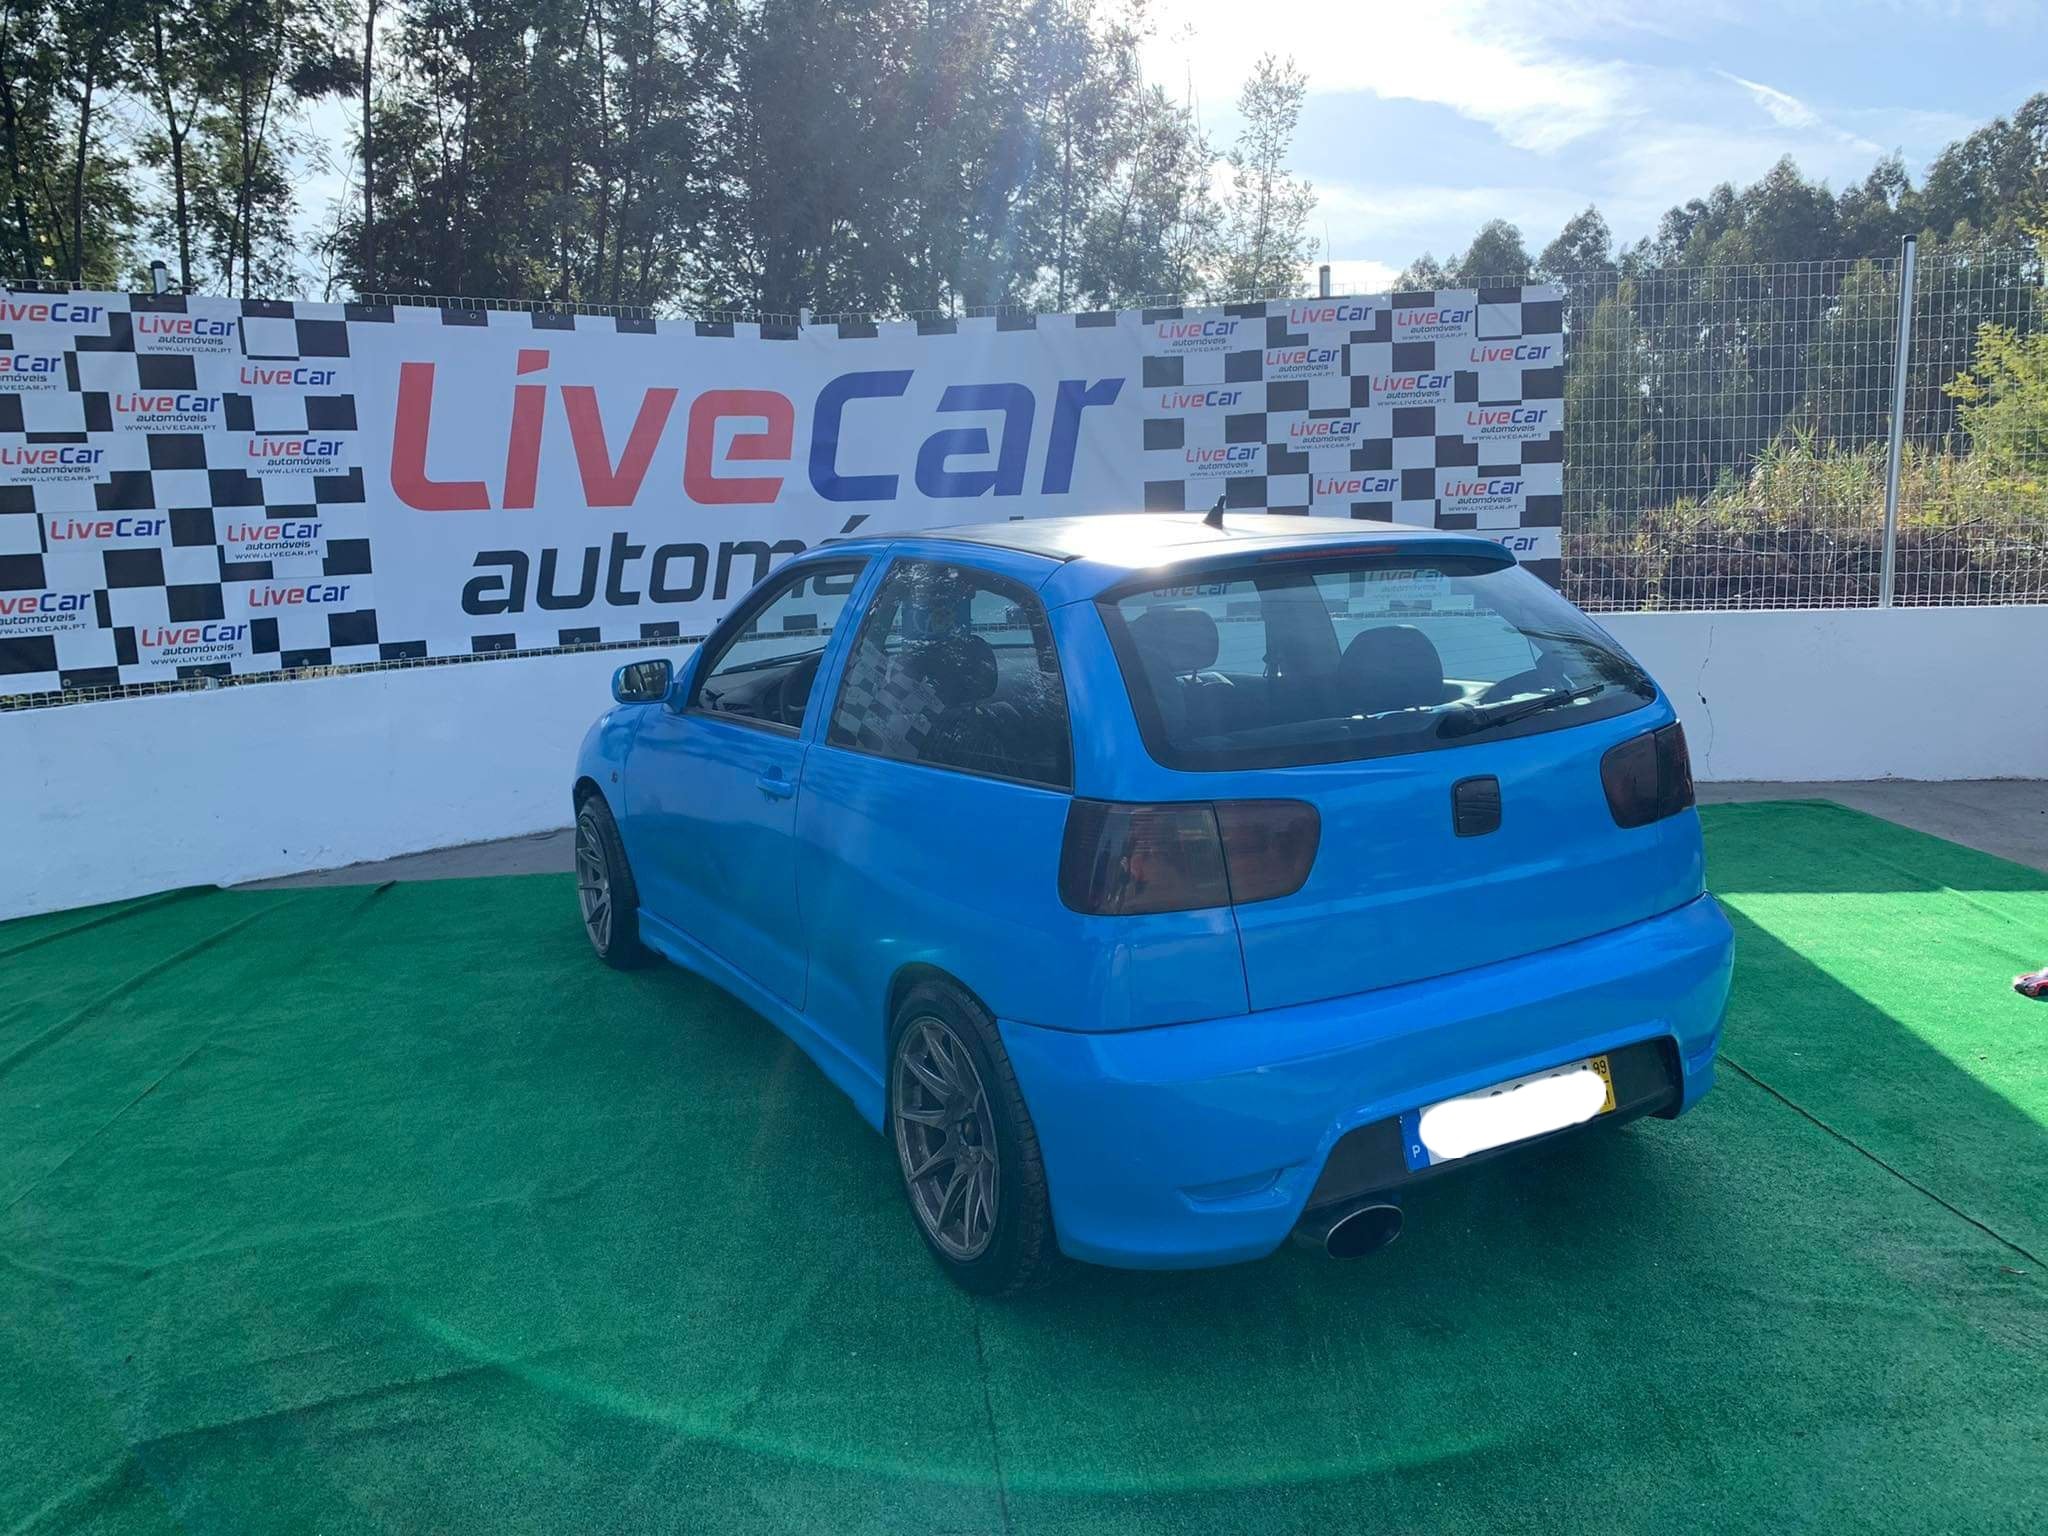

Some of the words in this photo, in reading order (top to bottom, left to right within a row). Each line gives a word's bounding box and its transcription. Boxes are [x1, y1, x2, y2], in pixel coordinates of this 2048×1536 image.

[0, 300, 103, 323] iveCar
[1290, 305, 1372, 324] LiveCar
[1397, 309, 1473, 326] LiveCar
[138, 315, 235, 336] LiveCar
[1158, 321, 1238, 339] LiveCar
[1410, 324, 1462, 334] automóveis
[158, 336, 224, 346] automóveis
[1266, 348, 1339, 366] LiveCar
[1470, 345, 1551, 363] LiveCar
[0, 355, 61, 373] eCar
[0, 373, 47, 382] móveis
[240, 366, 336, 385] LiveCar
[1373, 374, 1452, 392] LiveCar
[116, 392, 220, 412] LiveCar
[1161, 391, 1242, 409] LiveCar
[1386, 390, 1440, 400] automóveis
[136, 412, 208, 422] automóveis
[1467, 408, 1547, 426] LiveCar
[390, 349, 1126, 511] LiveCar
[1290, 421, 1361, 437] LiveCar
[1481, 424, 1535, 434] automóveis
[248, 438, 343, 456] LiveCar
[1302, 434, 1350, 443] automóveis
[2, 446, 104, 465] LiveCar
[267, 457, 331, 466] automóveis
[1186, 446, 1260, 463] LiveCar
[21, 465, 91, 474] automóveis
[256, 467, 340, 475] WWW.LIVECAR.PT
[1316, 477, 1399, 495] LiveCar
[1444, 480, 1524, 497] LiveCar
[1457, 495, 1512, 505] automóveis
[51, 518, 166, 540] LiveCar
[227, 522, 322, 542] LiveCar
[245, 541, 311, 551] automóveis
[0, 593, 91, 615] veCar
[249, 585, 350, 607] LiveCar
[142, 624, 247, 647] LiveCar
[162, 642, 234, 656] automóveis
[151, 653, 242, 665] WWW.LIVECAR.PT
[1593, 1060, 1607, 1075] 99
[1412, 1144, 1421, 1158] P
